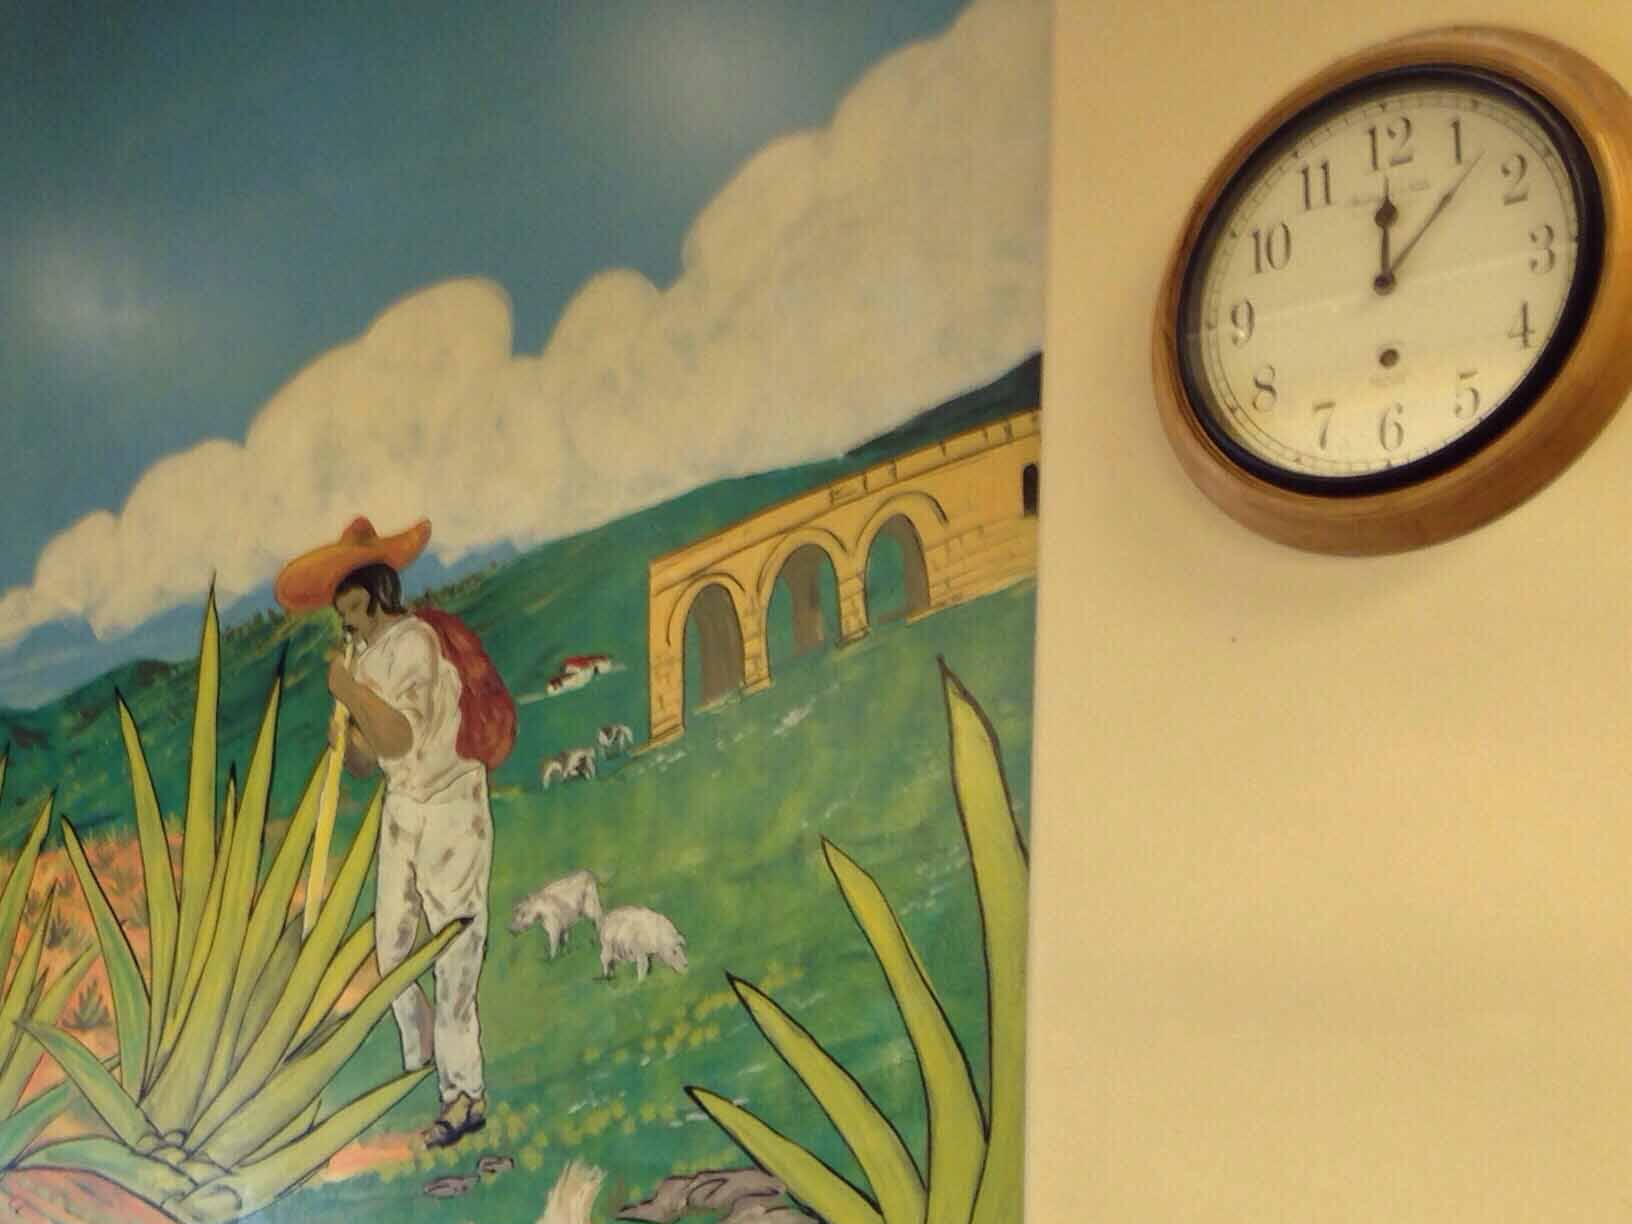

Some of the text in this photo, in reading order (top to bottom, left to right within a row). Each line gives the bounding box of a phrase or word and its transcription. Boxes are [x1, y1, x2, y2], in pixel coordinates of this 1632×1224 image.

[1365, 116, 1415, 170] 12
[1449, 119, 1465, 165] 1
[1297, 161, 1334, 212] 11
[1500, 153, 1529, 206] 2
[1250, 223, 1292, 275] 10
[1528, 224, 1557, 274] 3
[1230, 299, 1256, 347] 9
[1507, 303, 1535, 350] 4
[1252, 366, 1278, 412] 8
[1454, 372, 1480, 419] 5
[1312, 402, 1336, 451] 7
[1378, 403, 1405, 452] 6
